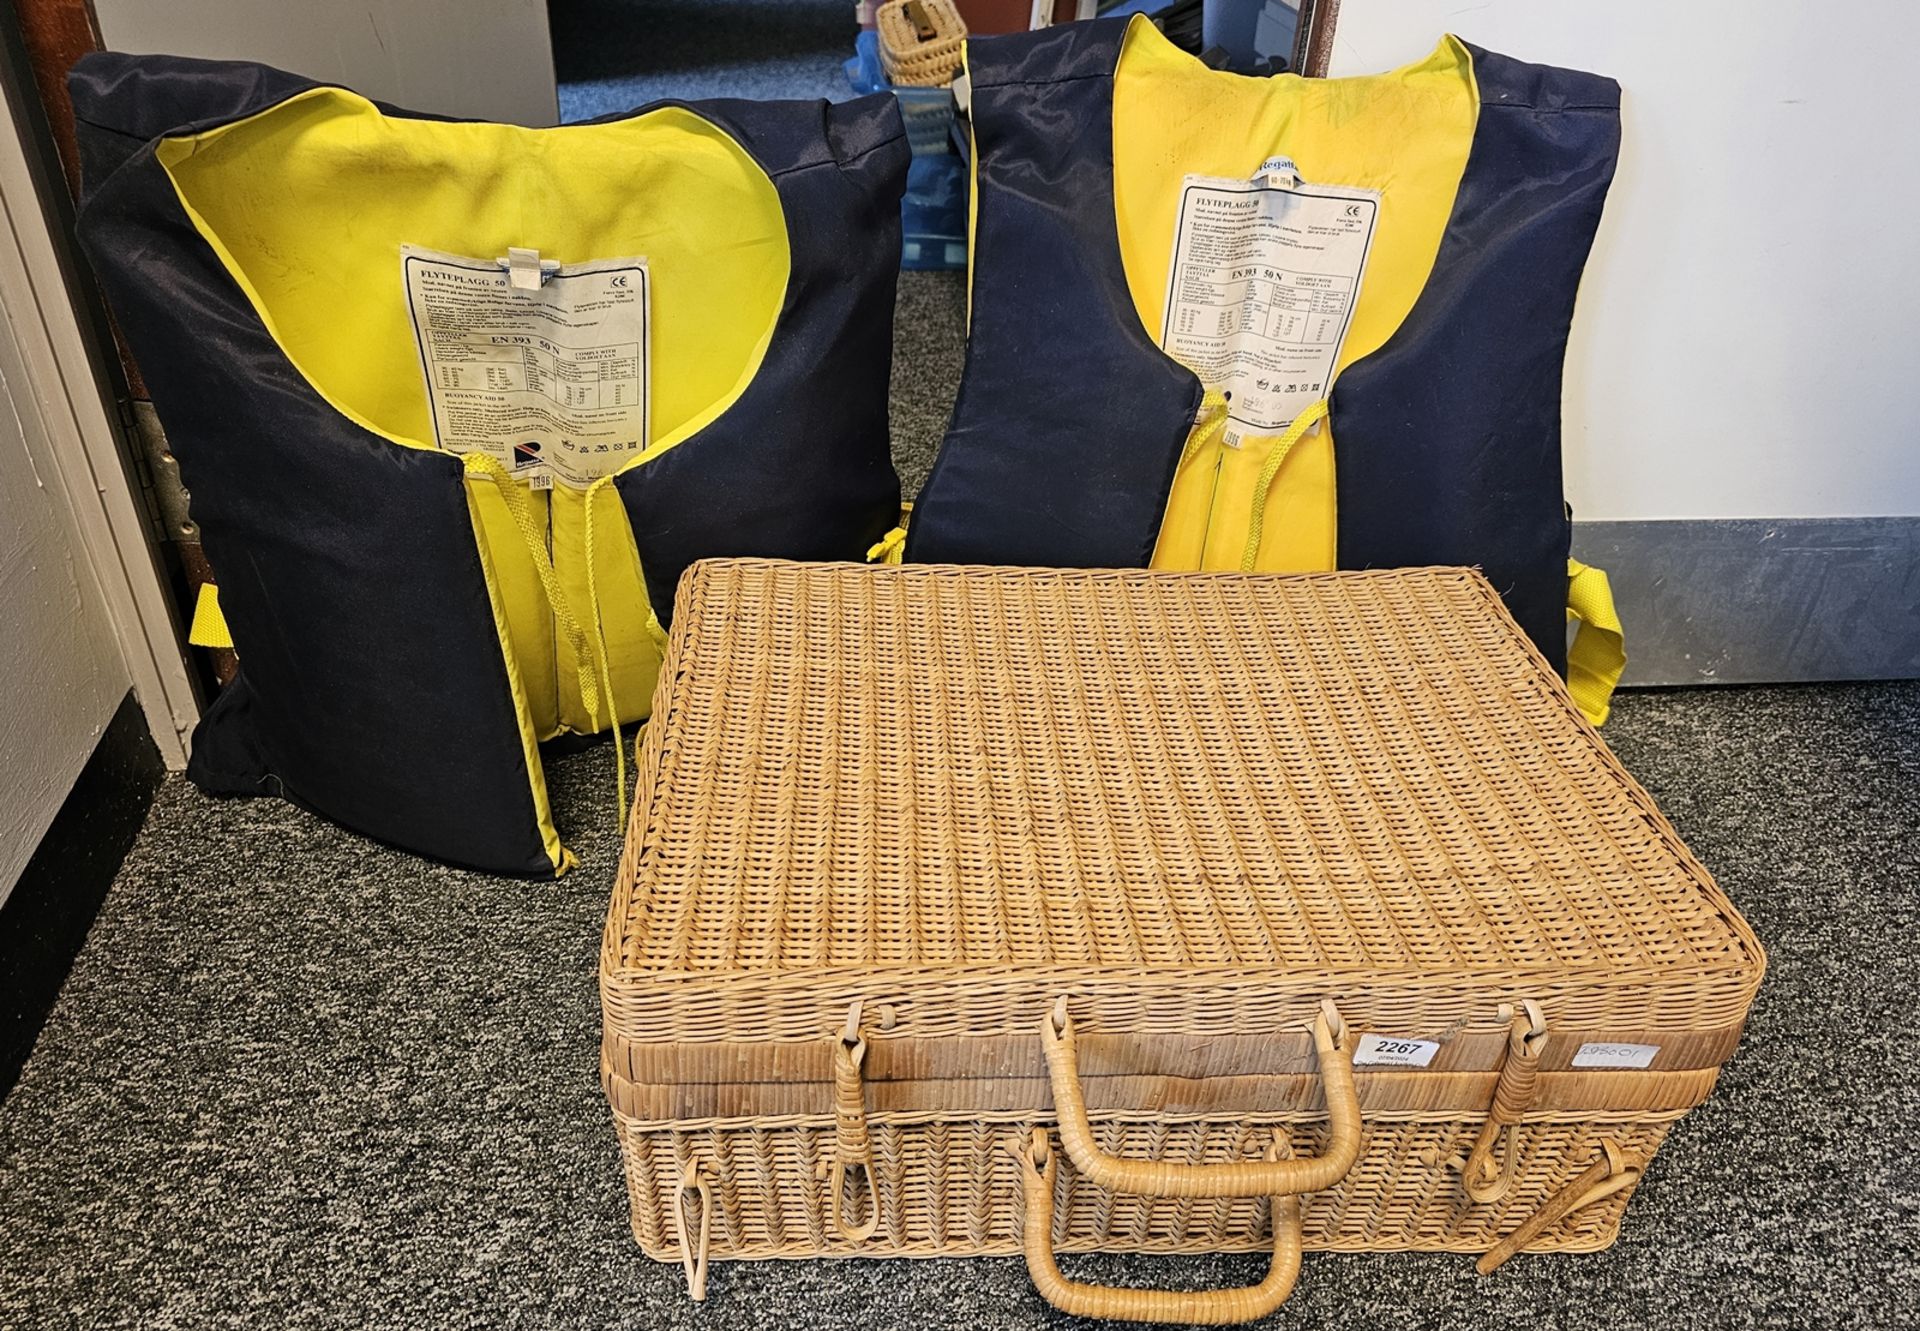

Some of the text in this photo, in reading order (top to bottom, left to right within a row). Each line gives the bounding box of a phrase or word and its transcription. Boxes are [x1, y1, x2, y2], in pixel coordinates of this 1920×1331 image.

[1196, 198, 1250, 208] FLYTEPLAGG
[421, 270, 490, 286] FLYTEPLAGG
[1232, 271, 1242, 279] EN
[1264, 269, 1274, 278] 50
[1275, 273, 1283, 281] N
[492, 336, 509, 344] EN
[540, 340, 550, 350] 50
[553, 346, 559, 355] N
[533, 475, 551, 488] 1996
[1375, 1040, 1422, 1054] 2267
